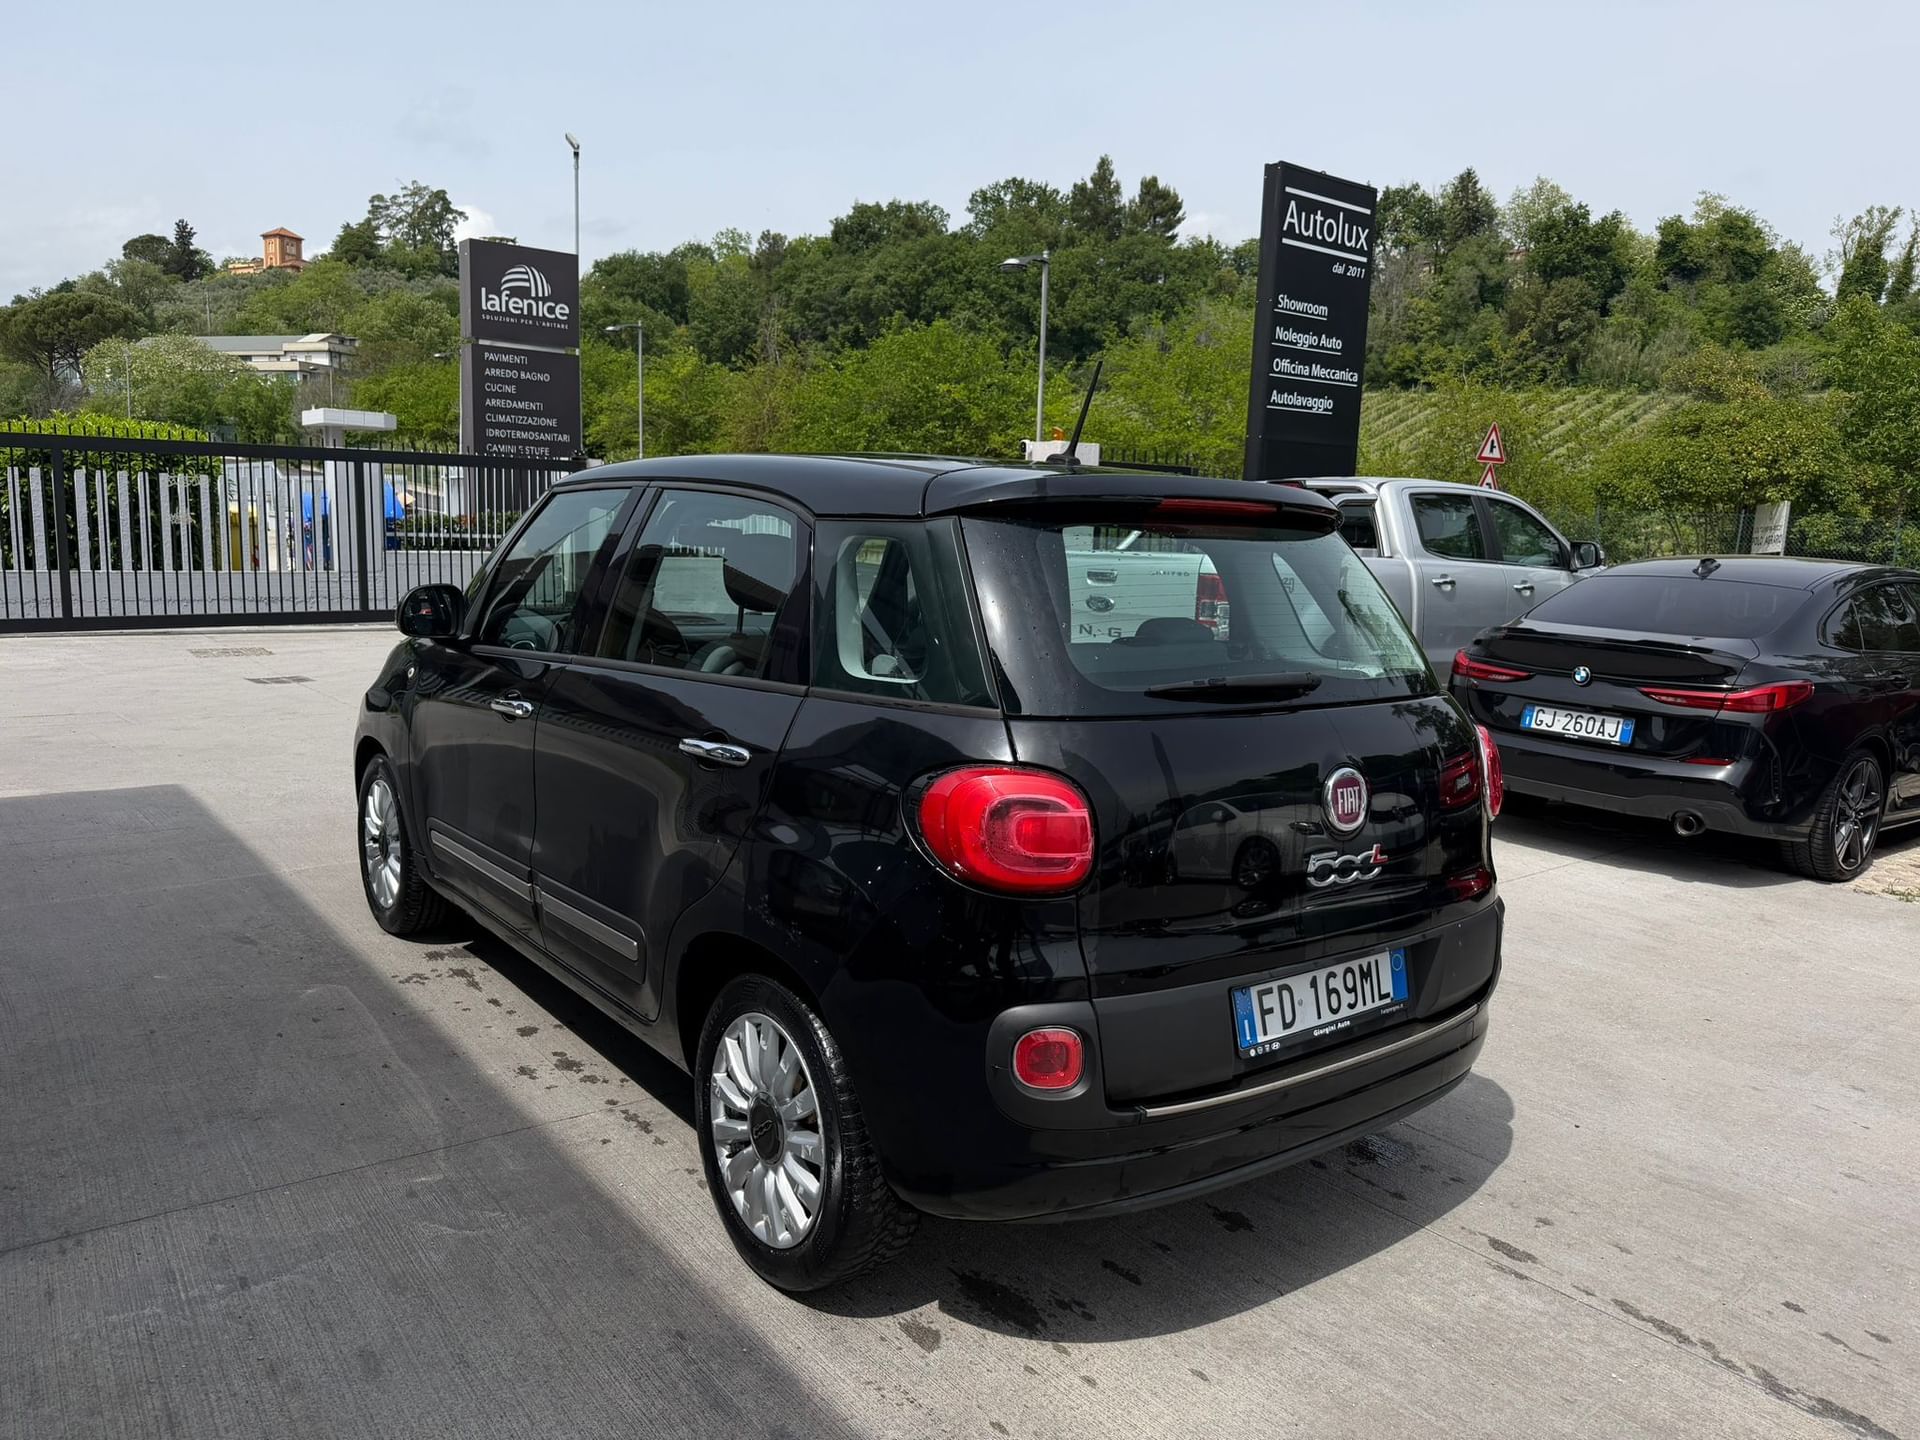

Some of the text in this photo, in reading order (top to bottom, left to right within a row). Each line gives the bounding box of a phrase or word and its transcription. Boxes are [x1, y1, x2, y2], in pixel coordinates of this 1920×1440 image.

[1282, 200, 1370, 251] Autolux
[1332, 262, 1366, 279] dal 2011
[481, 287, 570, 321] lafenice
[1277, 294, 1328, 316] Showroom
[481, 313, 518, 323] SOLUZIONI
[1275, 325, 1342, 350] Noleggio Auto
[484, 351, 528, 365] PAVIMENTI
[484, 367, 551, 382] ARREDO BAGNO
[1272, 357, 1358, 382] Officina Meccanica
[484, 382, 517, 394] CUCINE
[484, 398, 544, 411] ARREDAMENTI
[1270, 389, 1334, 412] Autolavaggio
[485, 412, 558, 427] CLIMATIZZAZIONE
[485, 428, 571, 443] IDROTERMOSANITARI
[486, 443, 517, 454] CAMINI
[525, 446, 550, 456] STUFE
[1534, 708, 1557, 729] GJ
[1562, 712, 1620, 739] 260AJ
[1336, 785, 1360, 815] FIAT
[1257, 983, 1297, 1037] FD
[1309, 959, 1391, 1021] 169ML
[1337, 1019, 1351, 1030] Auto
